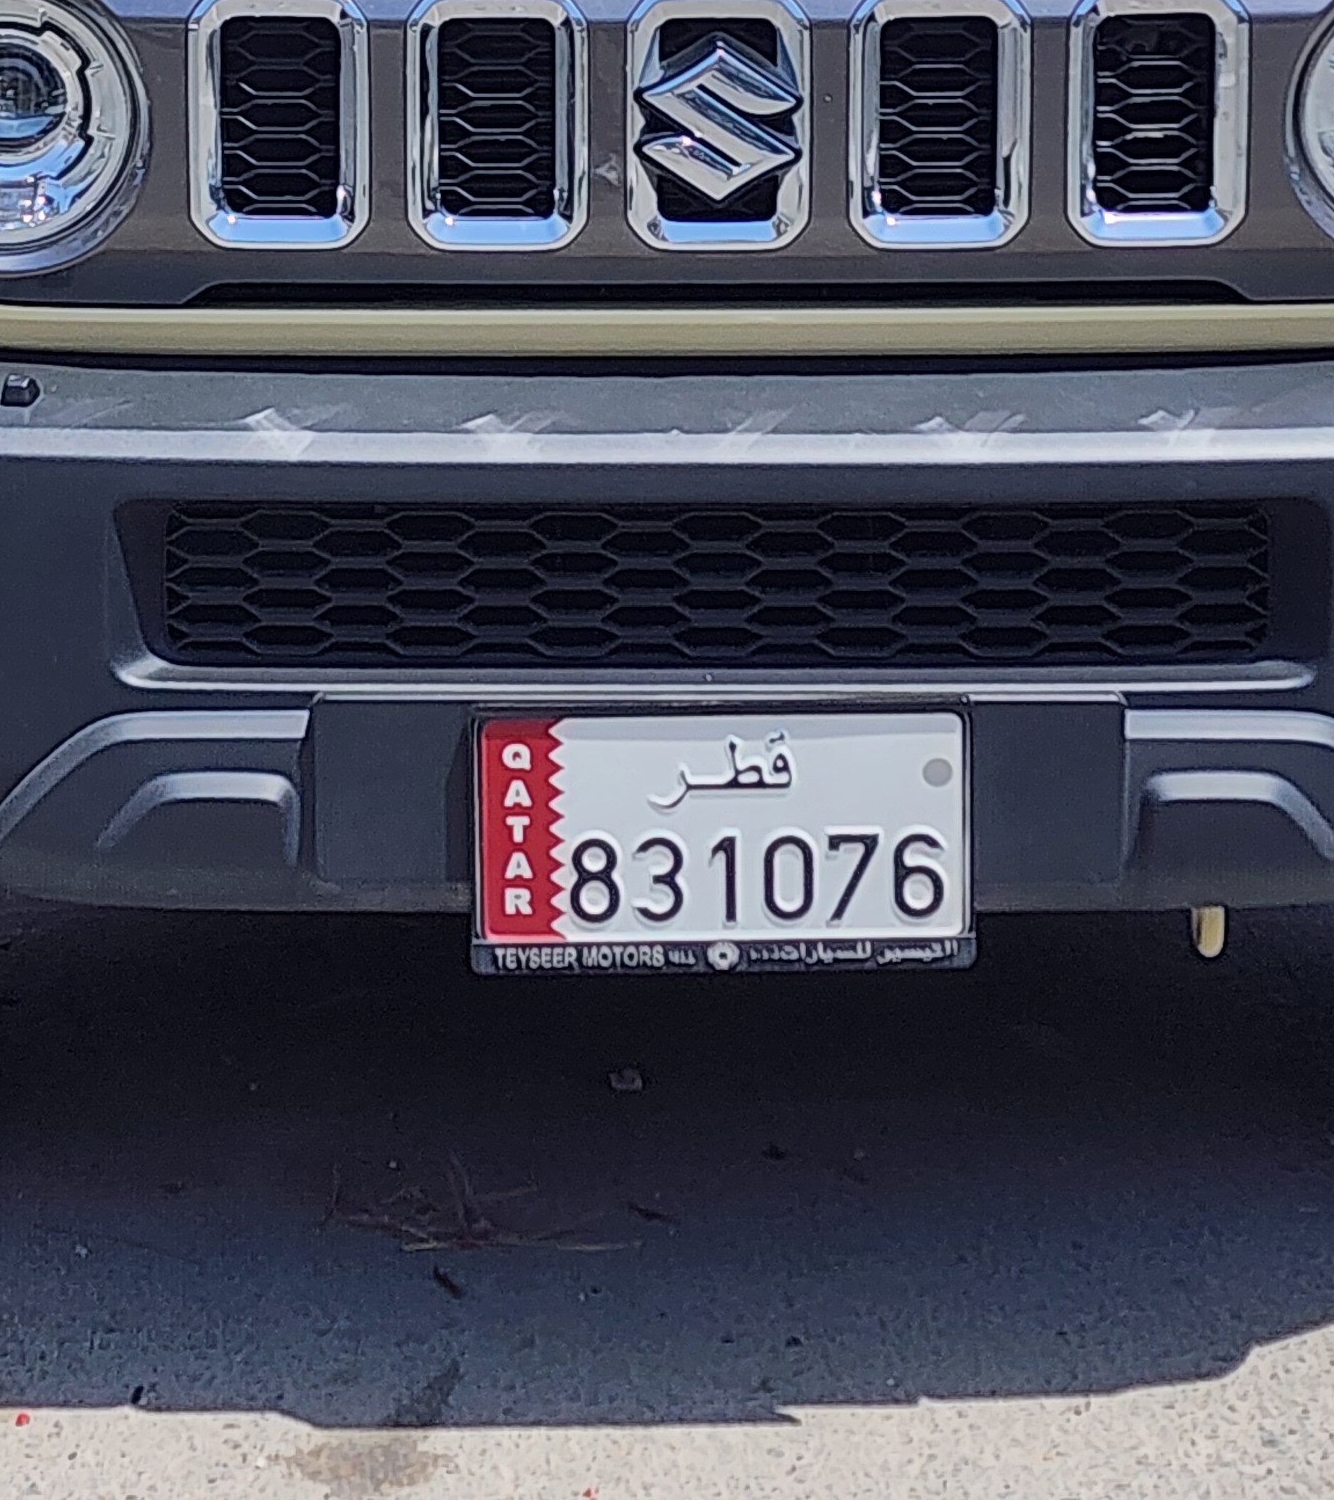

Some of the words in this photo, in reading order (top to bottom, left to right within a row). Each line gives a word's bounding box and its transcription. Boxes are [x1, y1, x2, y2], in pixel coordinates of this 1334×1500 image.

[647, 730, 795, 812] قطر
[501, 743, 534, 916] QATAR
[569, 831, 947, 925] 831076
[494, 946, 579, 970] TEYSEER
[582, 944, 665, 969] MOTORS
